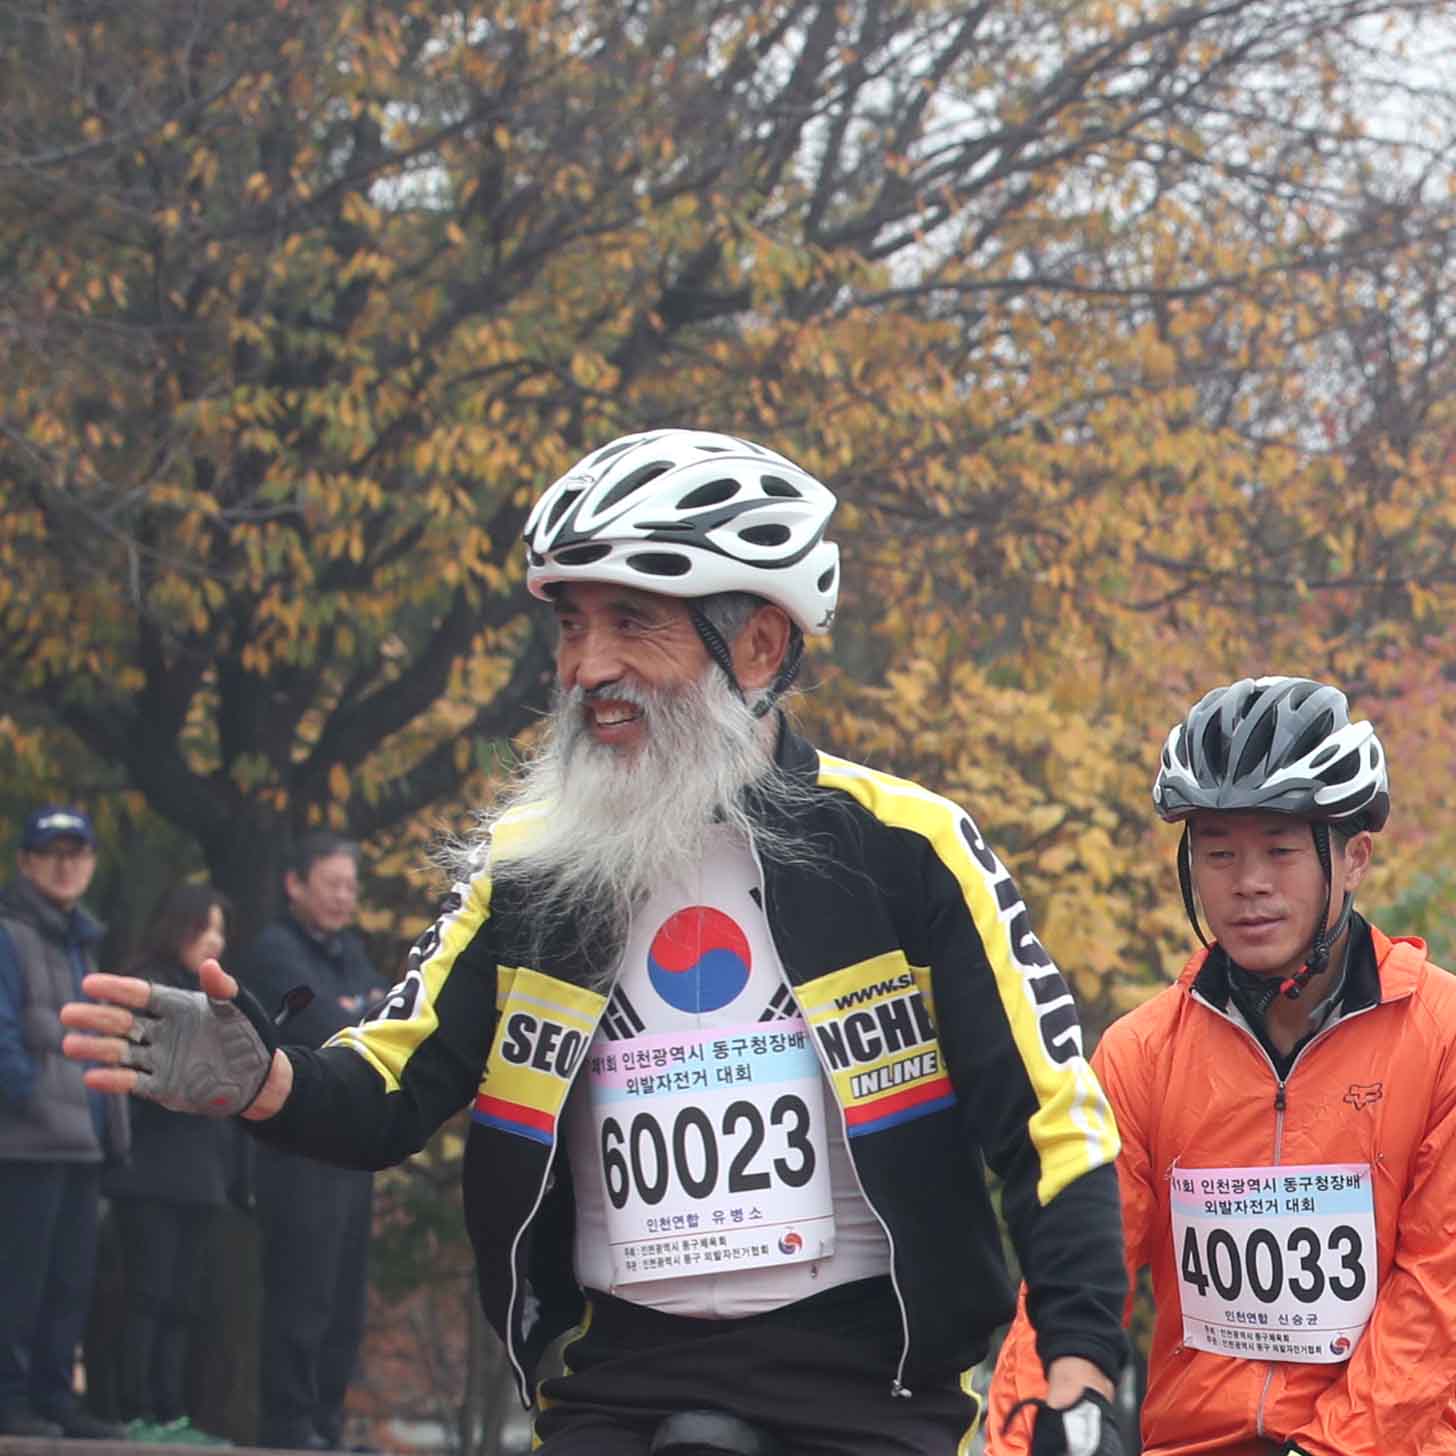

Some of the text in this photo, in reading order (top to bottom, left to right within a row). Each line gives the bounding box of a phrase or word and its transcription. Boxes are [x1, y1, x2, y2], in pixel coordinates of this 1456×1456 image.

[622, 1043, 704, 1071] 인천광역시
[712, 1032, 805, 1059] 동구청장배
[626, 1064, 752, 1095] 외발자전거 대회
[851, 1051, 937, 1098] INLINE
[601, 1094, 816, 1209] 60023
[1201, 1177, 1277, 1195] 인천광역시
[1283, 1174, 1361, 1193] 동구청장배
[646, 1213, 700, 1233] 인천연합
[1205, 1197, 1315, 1215] 외발자전거 대회
[1181, 1224, 1366, 1304] 40033
